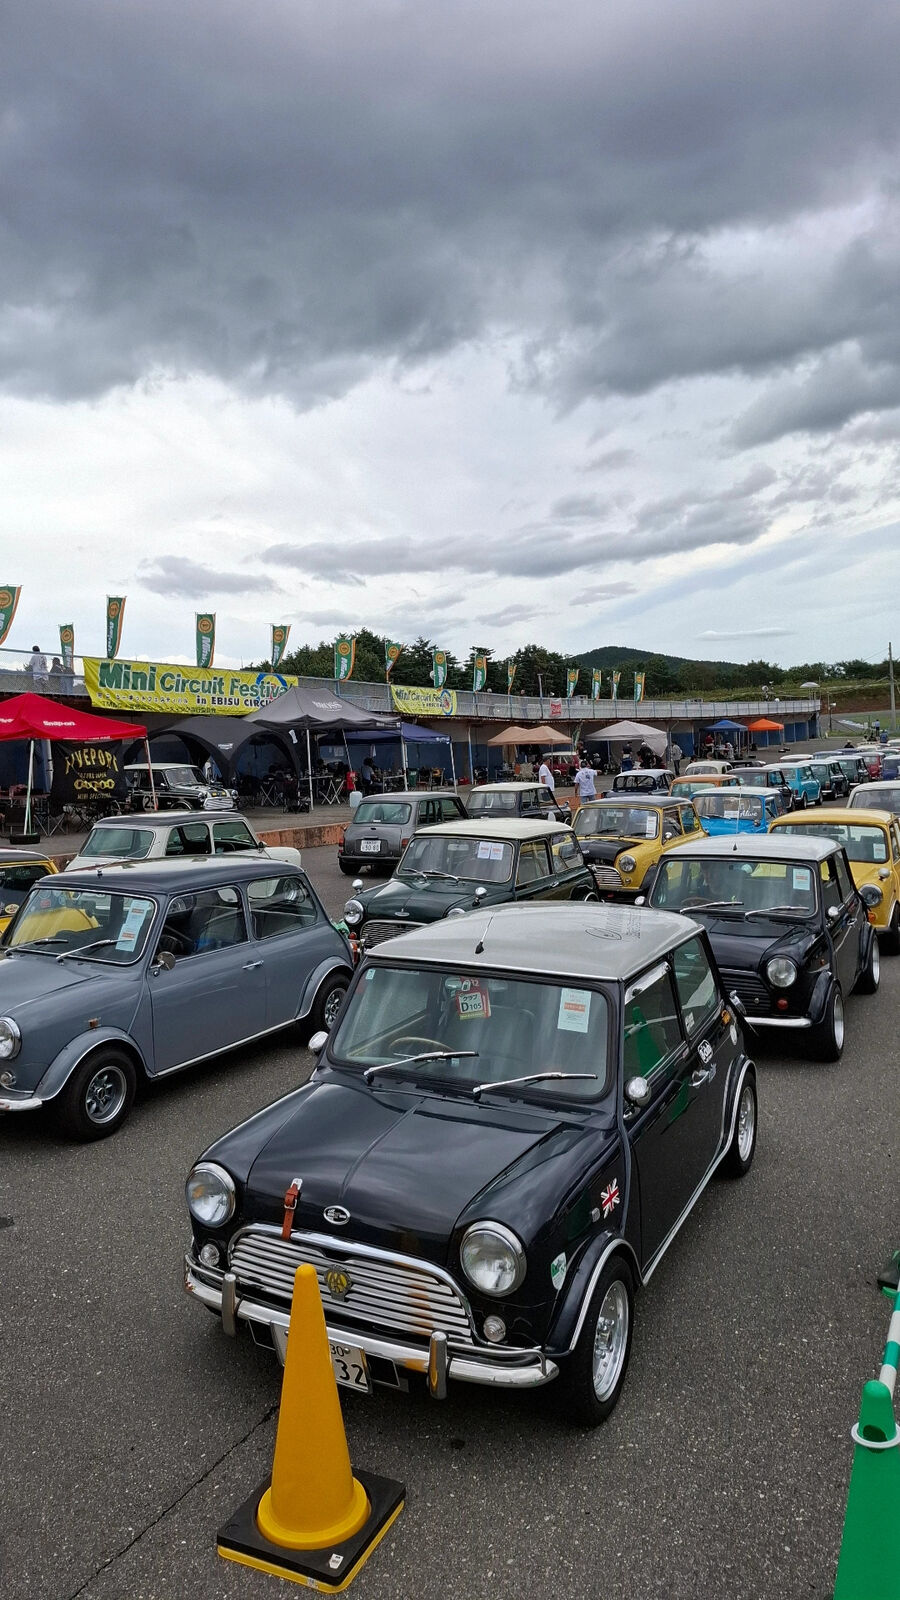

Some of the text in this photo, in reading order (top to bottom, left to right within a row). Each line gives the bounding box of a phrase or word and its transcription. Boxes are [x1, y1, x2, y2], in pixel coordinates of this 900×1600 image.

[99, 661, 156, 691] Mini
[160, 672, 225, 695] Circuit
[197, 695, 207, 705] in
[211, 696, 240, 706] EBISU
